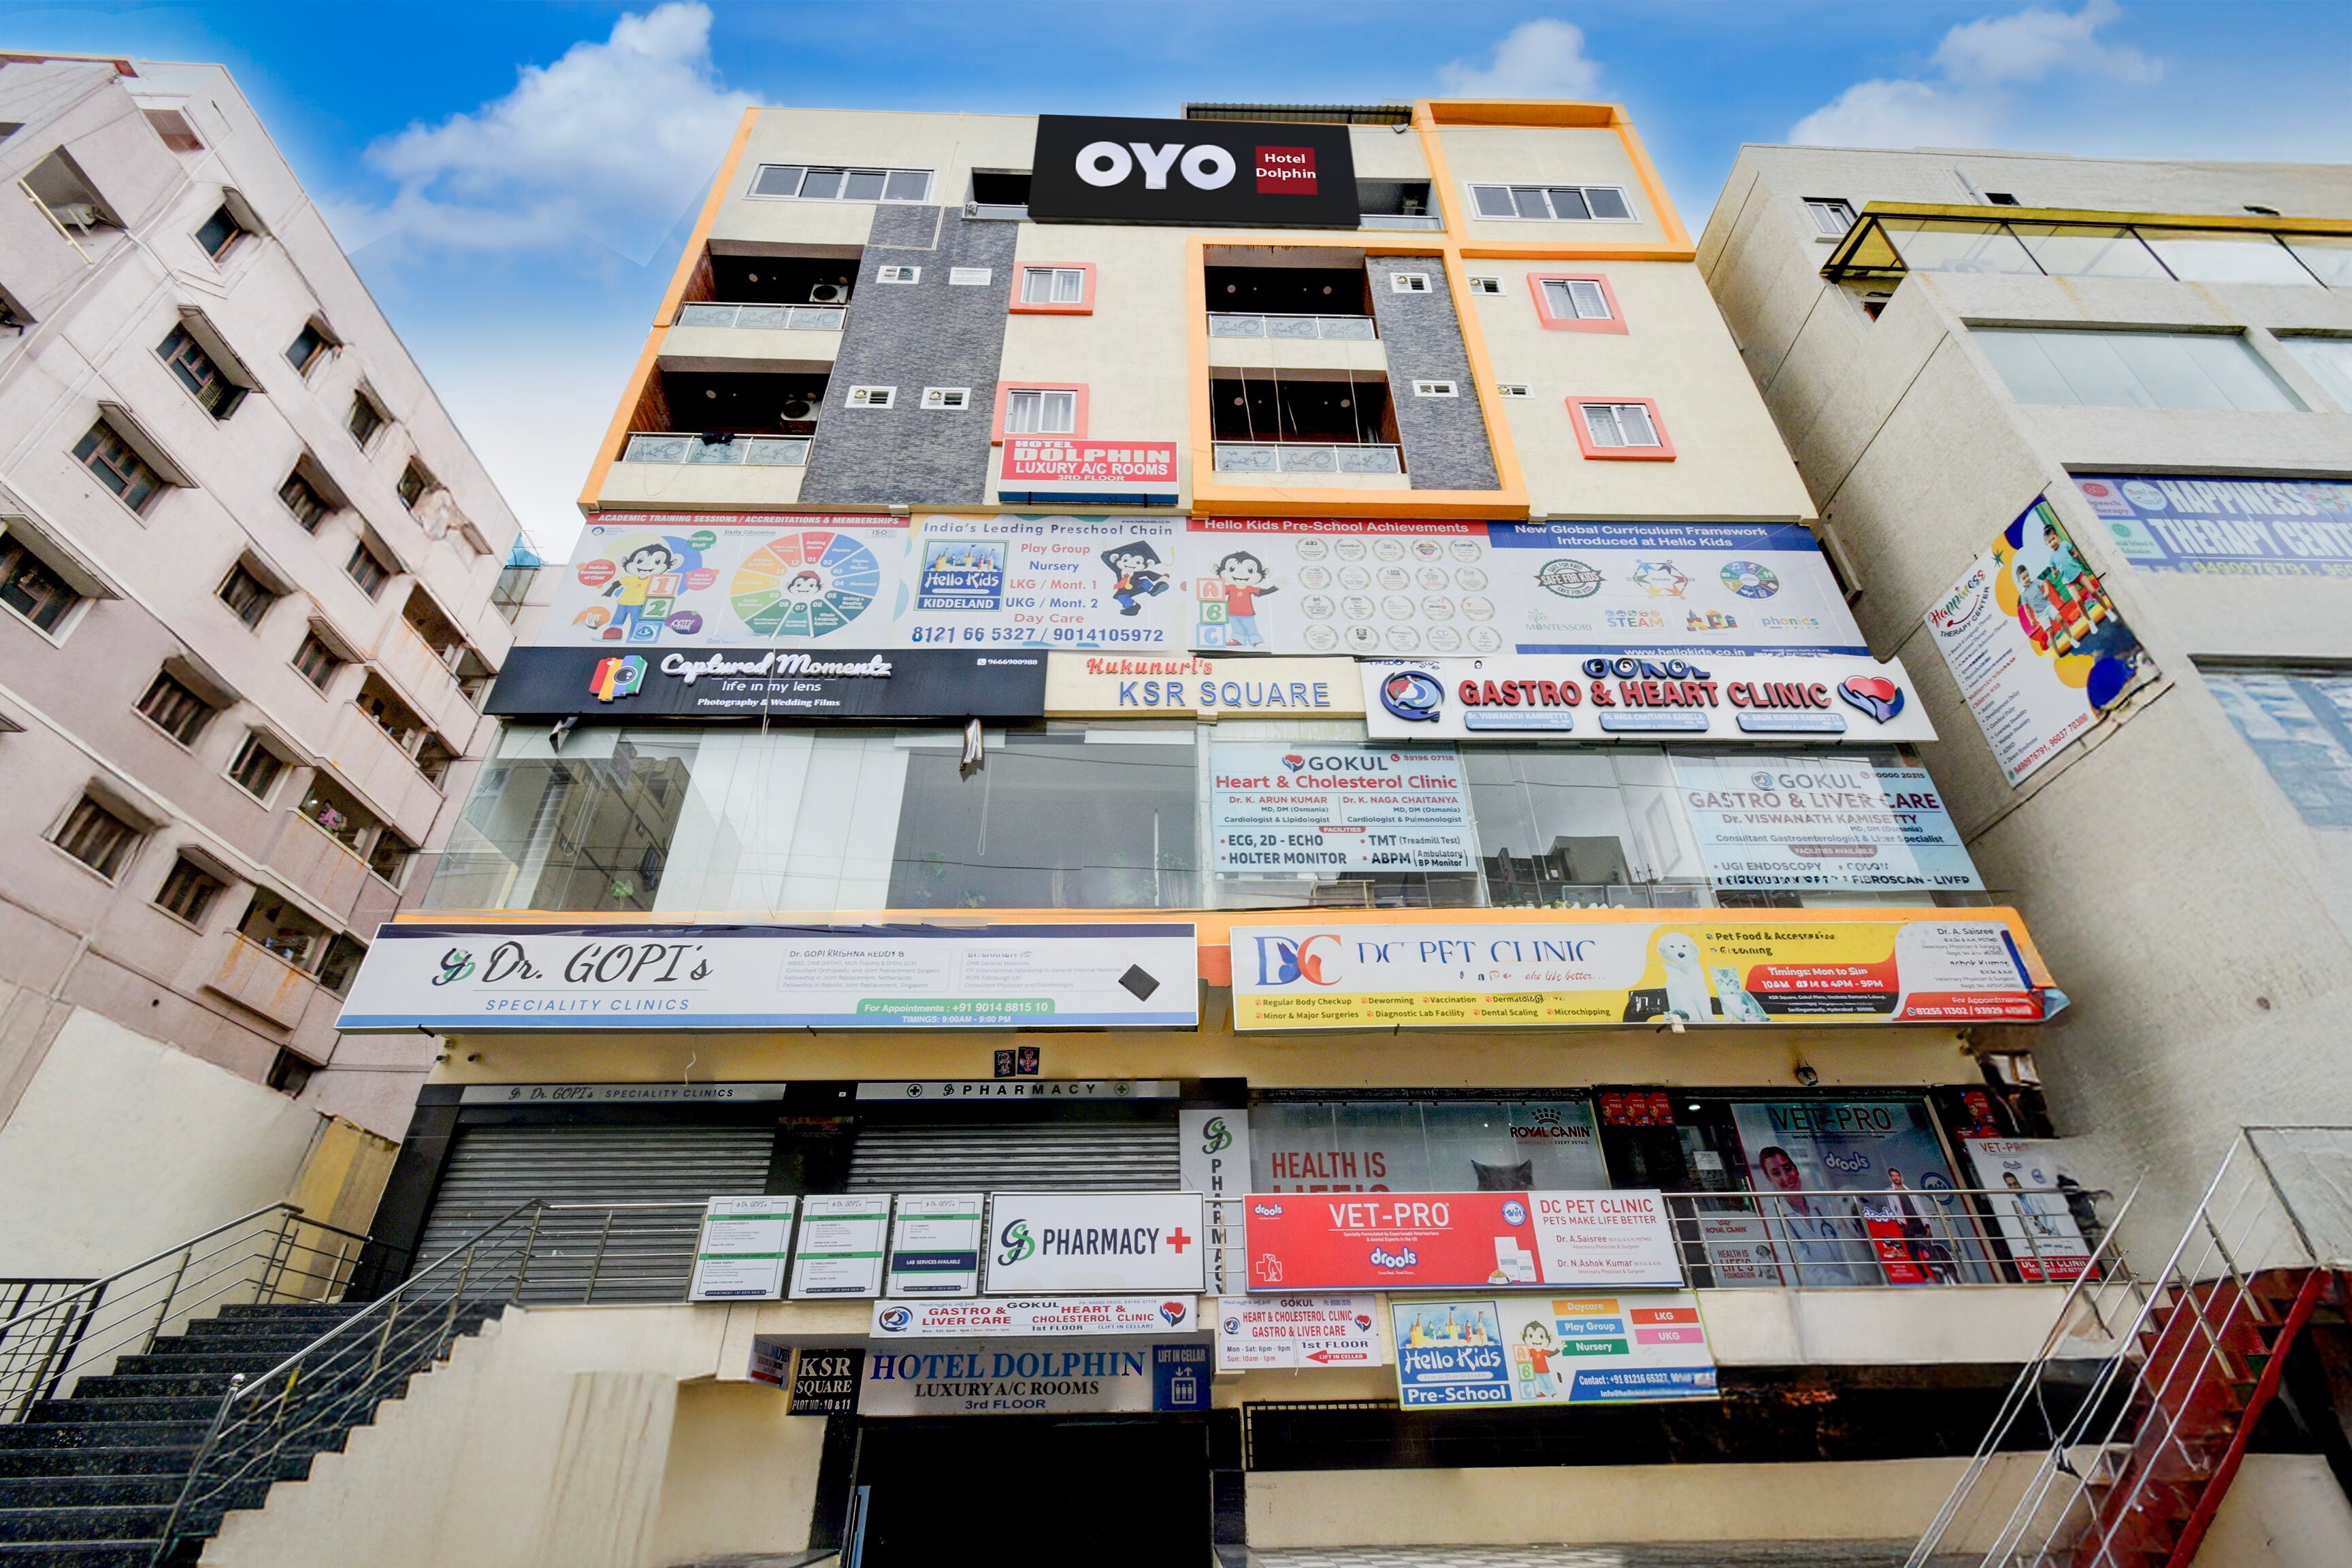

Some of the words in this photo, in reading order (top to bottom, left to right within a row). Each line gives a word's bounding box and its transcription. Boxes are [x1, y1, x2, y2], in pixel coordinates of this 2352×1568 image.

[1264, 153, 1305, 163] Hotel
[1075, 141, 1236, 190] OYO
[1256, 168, 1316, 180] Dolphin
[1013, 448, 1170, 463] DOLPHIN
[1015, 462, 1079, 474] LUXURY
[1081, 463, 1107, 474] A/C
[1112, 463, 1168, 475] ROOMS
[2157, 480, 2318, 516] HAPPINESS
[598, 514, 647, 523] ACADEMIC
[649, 515, 693, 523] TRAINING
[695, 515, 738, 523] SESSIONS
[744, 516, 822, 524] ACCREDITATIONS
[832, 517, 899, 525] MEMBERSHIPS
[1205, 519, 1242, 529] Hello
[1247, 520, 1279, 530] Kids
[1283, 520, 1362, 532] Pre-School
[1367, 521, 1469, 532] Achievements
[983, 523, 1043, 536] Leading
[1051, 525, 1123, 535] Preschool
[1130, 525, 1173, 536] Chain
[1515, 525, 1548, 534] New
[1551, 525, 1599, 535] Global
[1603, 526, 1682, 536] Curriculum
[1686, 527, 1767, 536] Framework
[1021, 544, 1046, 555] Play
[1051, 544, 1090, 556] Group
[1030, 561, 1079, 573] Nursery
[925, 572, 962, 588] Hello
[966, 574, 1000, 587] Kids
[1541, 575, 1563, 585] SAFE
[1564, 574, 1578, 583] FOR
[1579, 572, 1599, 581] KIDS
[923, 599, 994, 608] KIDDELAND
[1929, 569, 1985, 628] Happiness
[1940, 623, 1972, 637] THERAPY
[1972, 586, 1990, 621] CENTER
[1015, 614, 1044, 625] Day
[1049, 615, 1084, 623] Care
[1608, 618, 1665, 627] STEAM
[1762, 615, 1818, 628] phonics
[912, 627, 955, 642] 8121
[964, 627, 985, 642] 66
[992, 627, 1035, 642] 5327
[1054, 629, 1163, 642] 9014105972
[661, 652, 775, 686] Captured
[776, 654, 892, 676] Momentz
[1087, 657, 1213, 674] Kukunuri's
[722, 681, 746, 691] life
[751, 681, 763, 691] in
[768, 683, 788, 693] my
[794, 681, 821, 691] lens
[1120, 681, 1186, 705] KSR
[1200, 682, 1330, 706] SQUARE
[1459, 680, 1582, 706] GASTRO
[1590, 681, 1616, 706] &
[1619, 681, 1719, 706] HEART
[1727, 682, 1831, 708] CLINIC
[2002, 741, 2016, 755] ADHD
[1216, 776, 1270, 788] Heart
[1277, 775, 1289, 788] &
[1296, 775, 1402, 789] Cholesterol
[1408, 774, 1457, 788] Clinic
[1779, 774, 1861, 789] GOKUL
[1689, 792, 1780, 808] GASTRO
[1790, 793, 1803, 807] &
[1813, 793, 1878, 808] LIVER
[1880, 793, 1939, 808] CARE
[1228, 835, 1257, 847] ECG,
[1260, 835, 1277, 846] 2D
[1288, 835, 1323, 846] ECHO
[1229, 853, 1281, 864] HOLTER
[1284, 853, 1347, 864] MONITOR
[1747, 862, 1822, 870] ENDOSCOPY
[1852, 875, 1923, 884] FIBROSCAN
[482, 941, 542, 983] Dr.
[564, 943, 713, 983] GOPI's
[1767, 967, 1811, 976] Timings:
[486, 999, 601, 1011] SPECIALITY
[610, 999, 689, 1011] CLINICS
[1296, 998, 1316, 1007] Body
[1369, 996, 1414, 1004] Deworming
[882, 1004, 944, 1013] Appointments
[952, 1003, 971, 1012] +91
[976, 1003, 1002, 1012] 9014
[1004, 1003, 1032, 1012] 8815
[1035, 1003, 1047, 1011] 10
[962, 1083, 1096, 1096] PHARMACY
[1769, 1107, 1892, 1131] VET-PRO
[1510, 1126, 1549, 1138] ROYAL
[1551, 1126, 1590, 1137] CANIN
[1272, 1152, 1356, 1178] HEALTH
[1365, 1152, 1386, 1177] IS
[1825, 1152, 1869, 1171] drools
[1540, 1200, 1561, 1213] DC
[1566, 1200, 1595, 1213] PET
[1601, 1199, 1654, 1213] CLINIC
[1328, 1203, 1450, 1228] VET-PRO
[1598, 1216, 1618, 1224] LIFE
[1621, 1215, 1656, 1224] BETTER
[1043, 1228, 1160, 1256] PHARMACY
[1371, 1247, 1416, 1268] drools
[1281, 1299, 1314, 1307] GOKUL
[1567, 1302, 1604, 1312] Daycare
[1654, 1311, 1673, 1322] LKG
[1658, 1331, 1680, 1341] UKG
[1158, 1349, 1173, 1363] LIFT
[1175, 1349, 1183, 1362] IN
[1183, 1349, 1206, 1363] CELLAR
[1405, 1350, 1454, 1374] Hello
[1456, 1348, 1501, 1371] Kids
[799, 1358, 851, 1377] KSR
[870, 1352, 985, 1380] HOTEL
[993, 1351, 1144, 1377] DOLPHIN
[796, 1380, 851, 1396] SQUARE
[914, 1383, 994, 1397] LUXURY
[995, 1381, 1026, 1397] A/C
[1030, 1381, 1099, 1396] ROOMS
[1407, 1385, 1506, 1403] Pre-School
